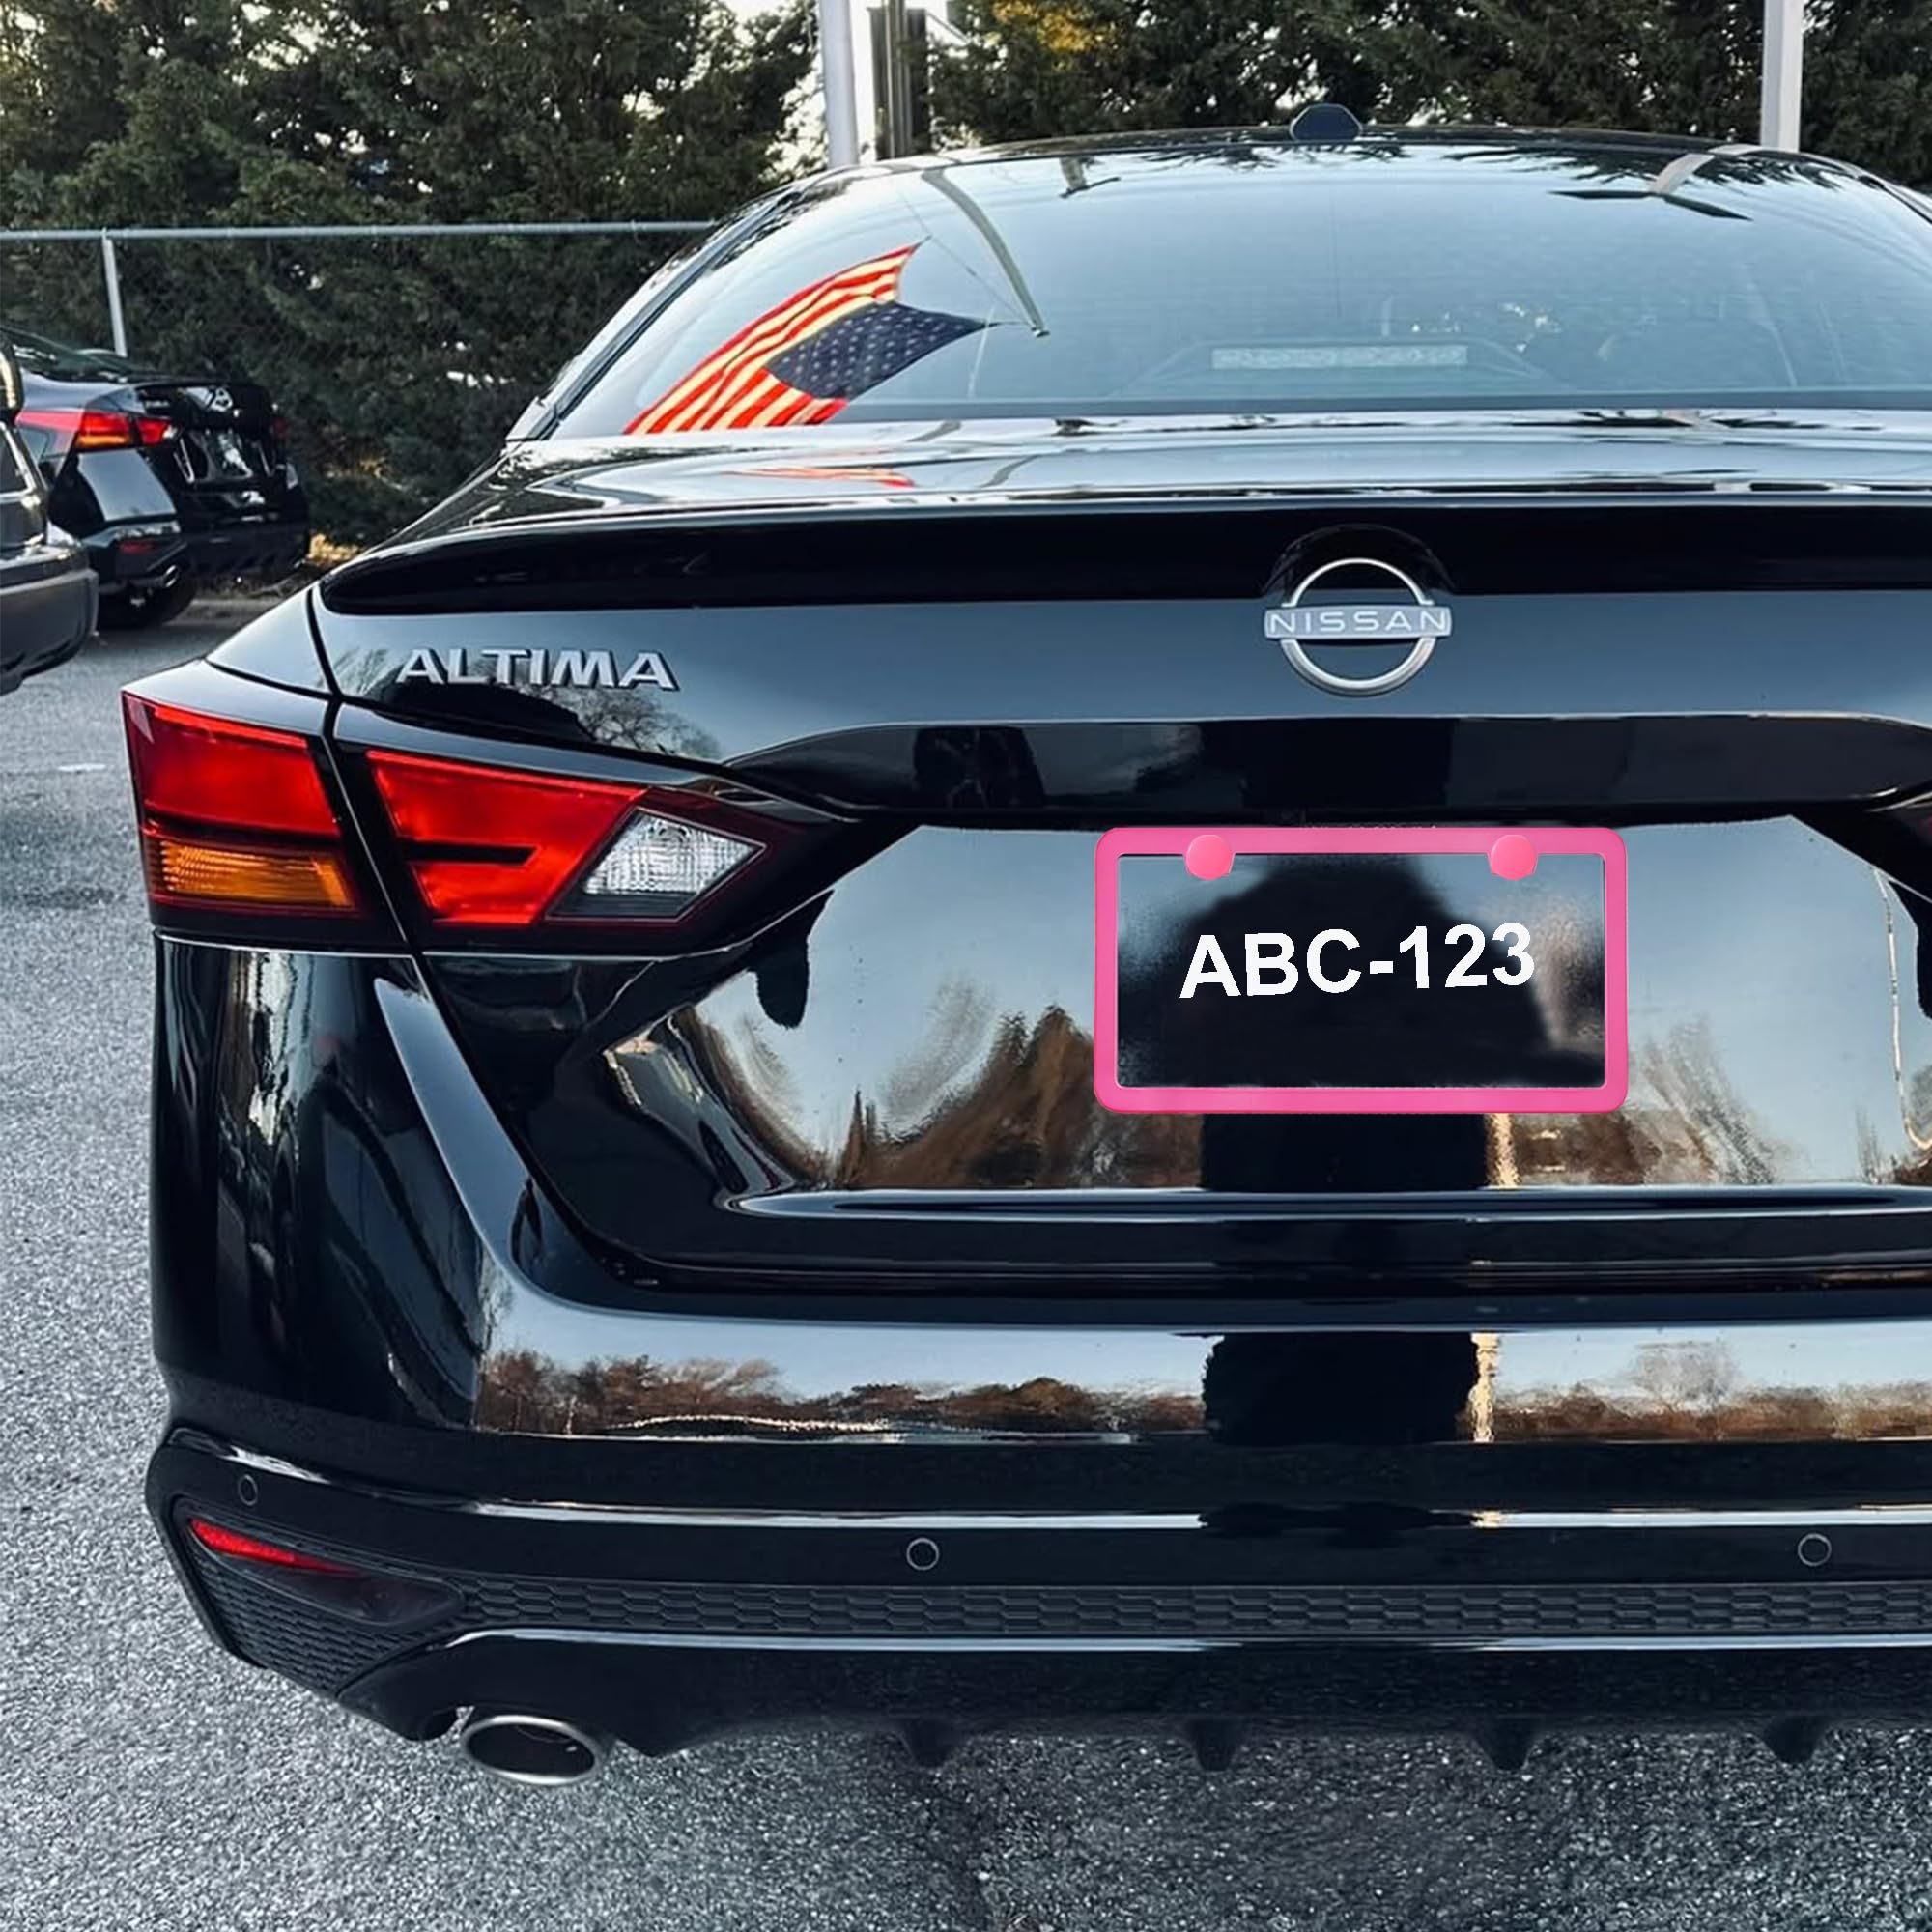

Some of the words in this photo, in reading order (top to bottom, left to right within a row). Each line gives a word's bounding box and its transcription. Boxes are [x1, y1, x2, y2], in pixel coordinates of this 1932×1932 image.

[1269, 610, 1447, 633] NISSAN
[394, 648, 678, 691] ALTIMA
[1179, 922, 1536, 999] ABC-123
